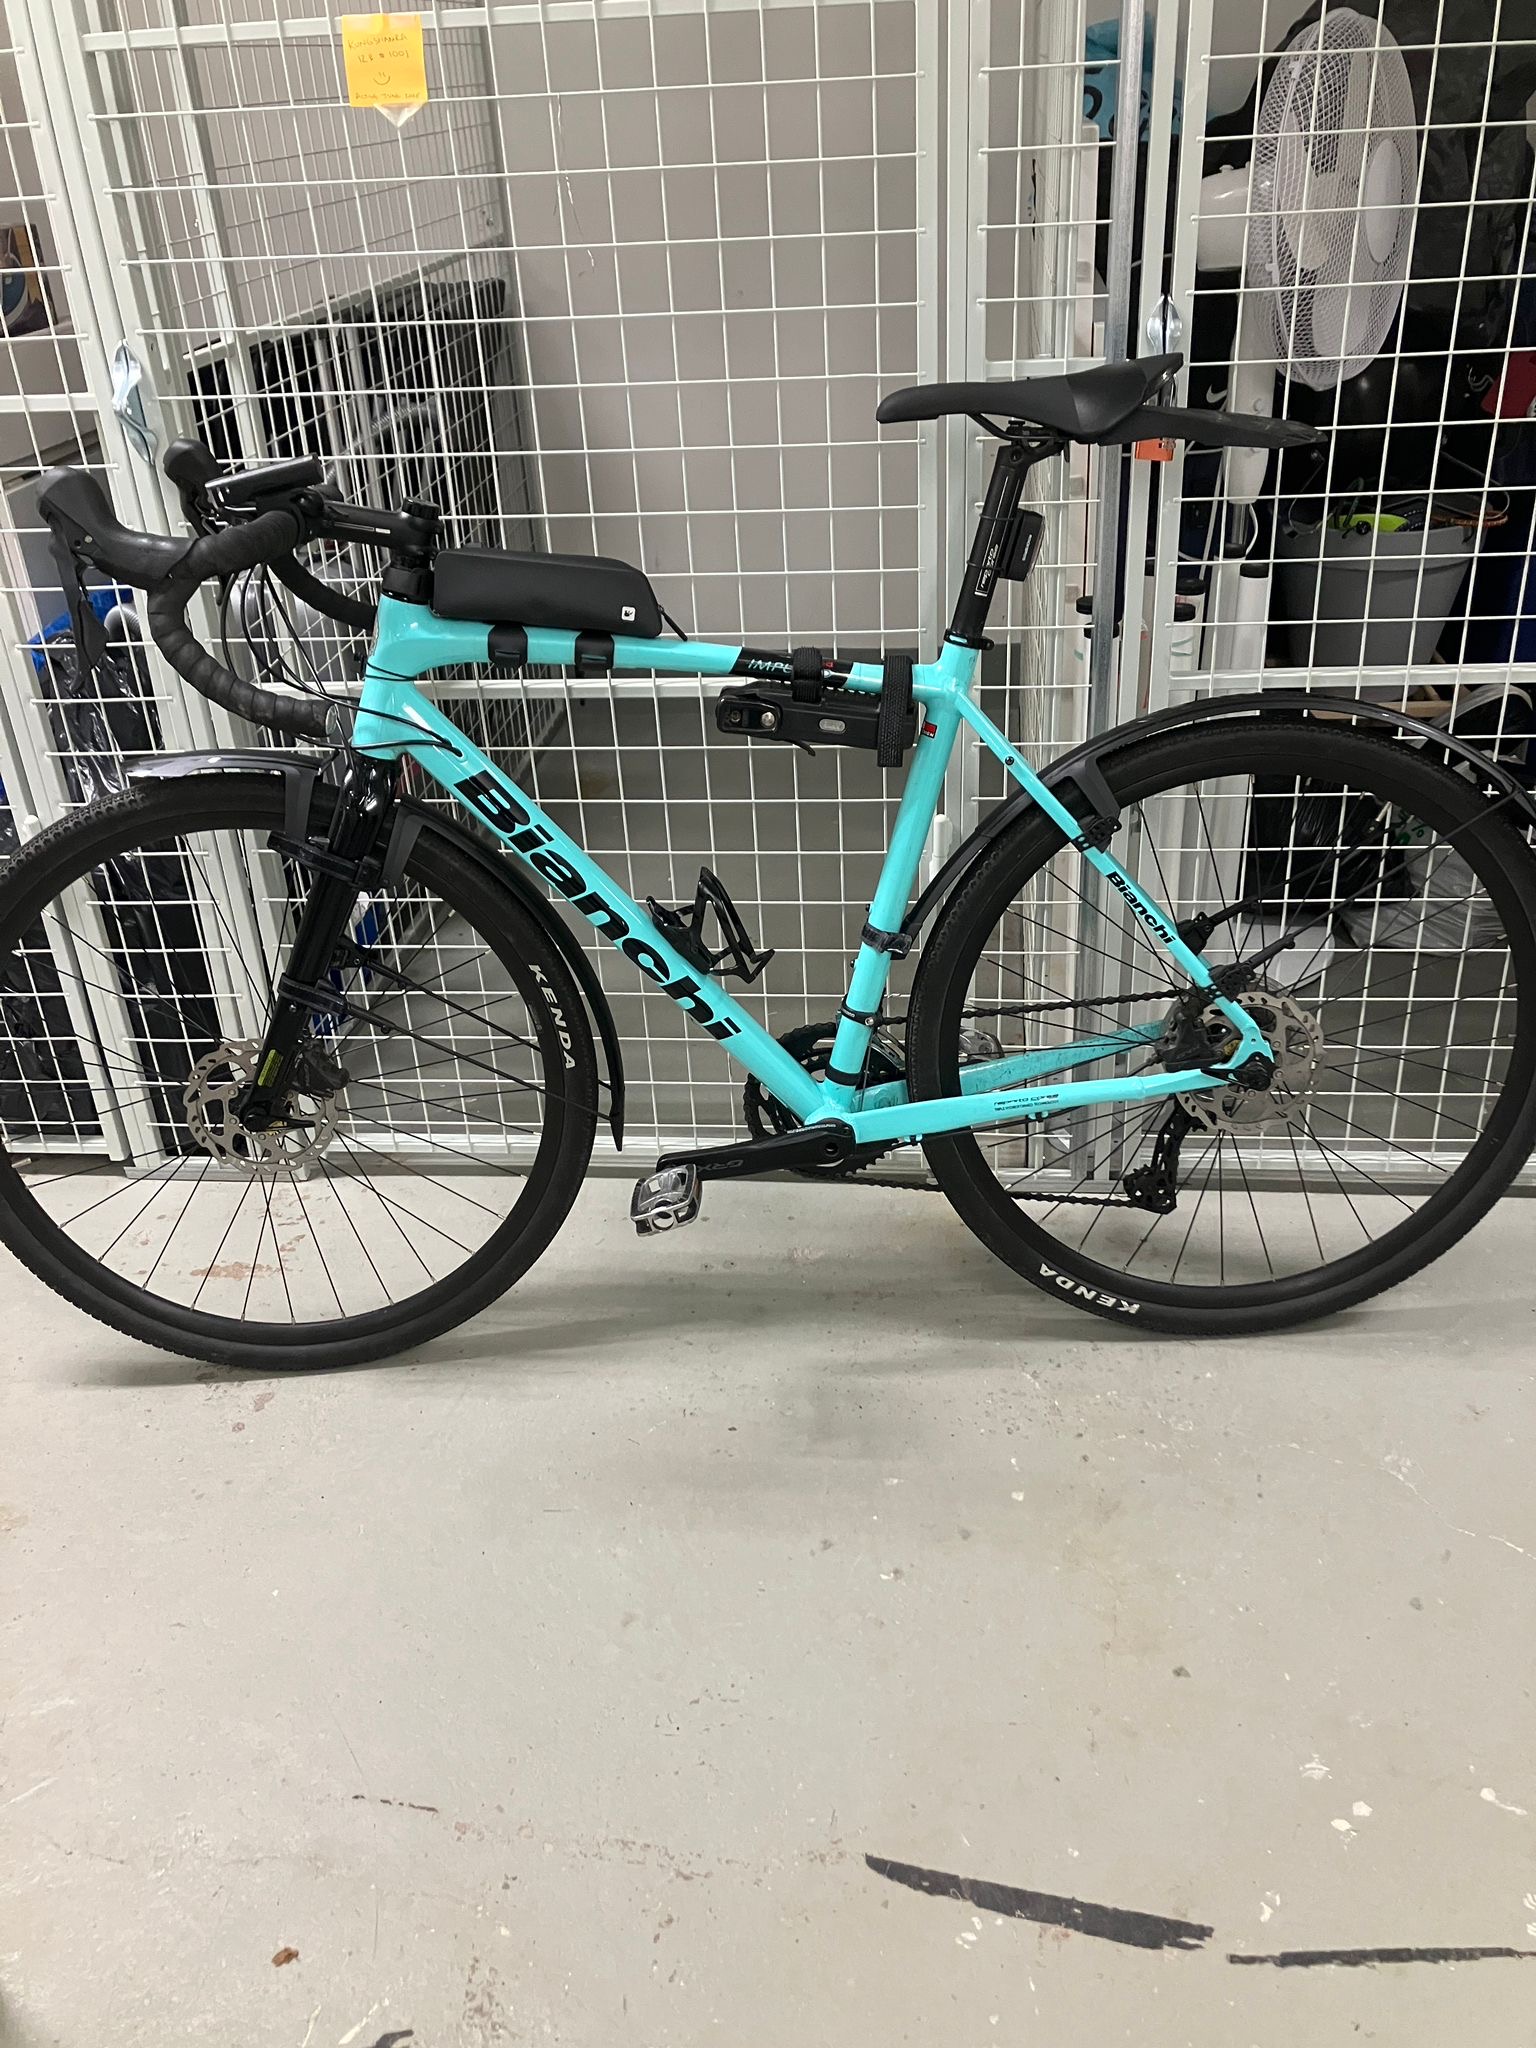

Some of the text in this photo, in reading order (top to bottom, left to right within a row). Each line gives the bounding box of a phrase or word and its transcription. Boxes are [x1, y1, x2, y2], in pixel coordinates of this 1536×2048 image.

[453, 769, 742, 1041] Bianchi
[1106, 870, 1176, 944] Bianchi
[528, 964, 576, 1069] KENDA
[1039, 1263, 1141, 1314] KENDA
